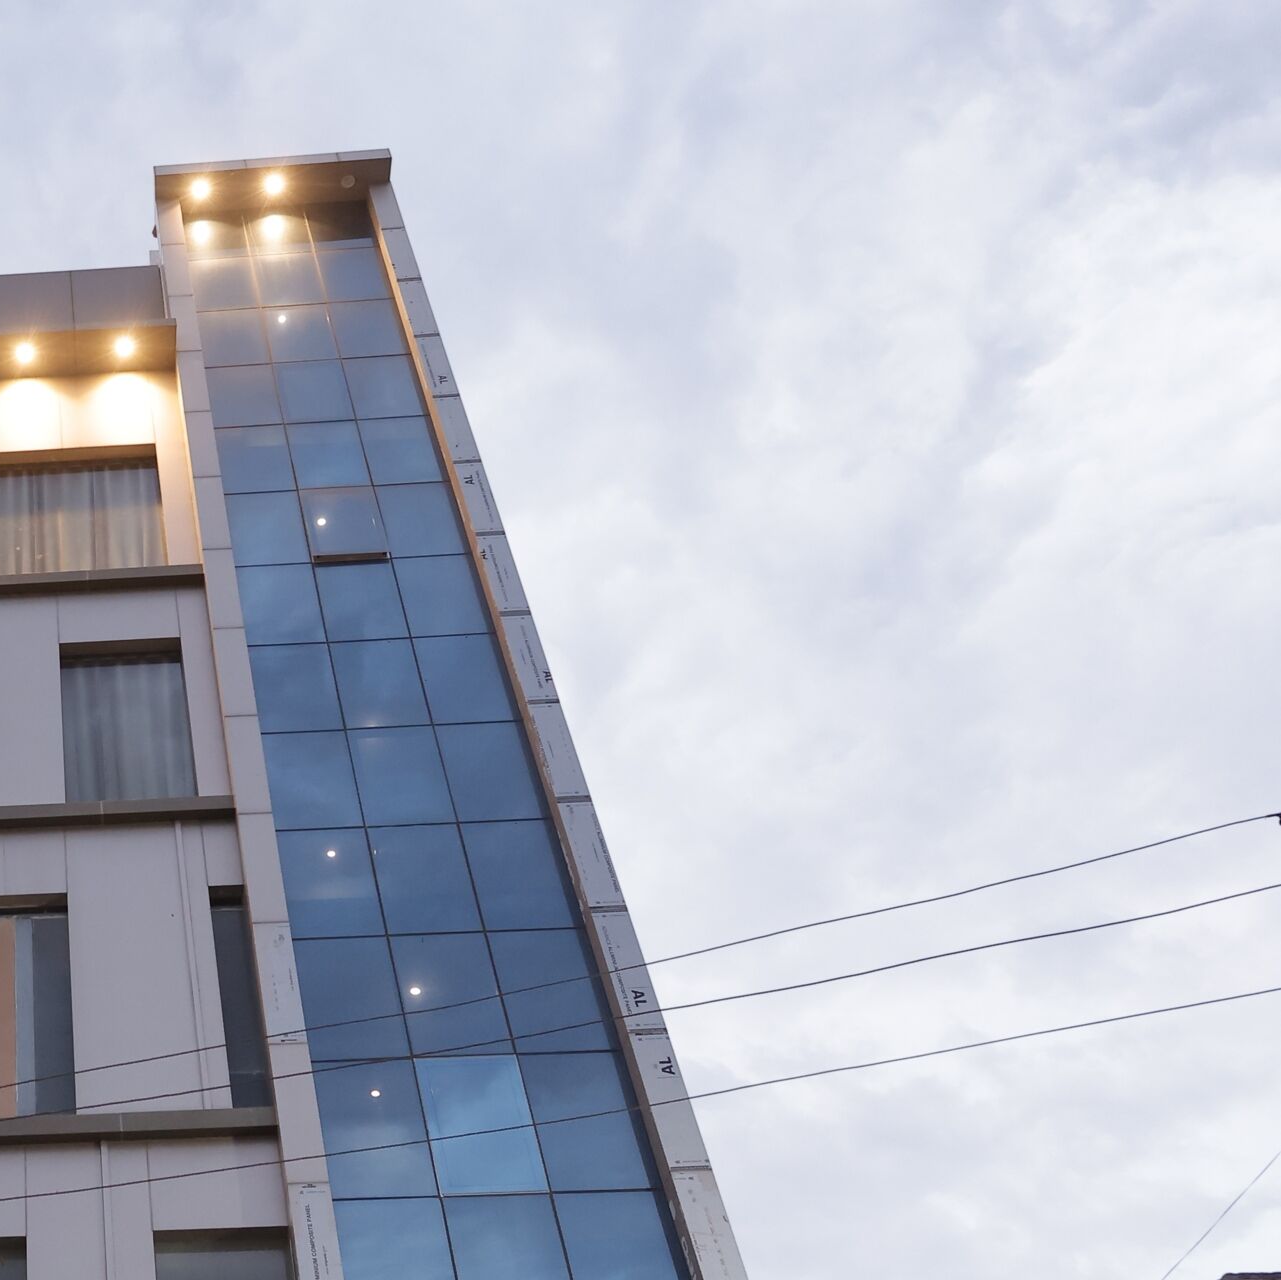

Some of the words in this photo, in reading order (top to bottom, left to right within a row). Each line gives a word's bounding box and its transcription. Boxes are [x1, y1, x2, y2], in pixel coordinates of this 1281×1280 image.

[463, 474, 475, 485] AL
[631, 989, 647, 1007] AL
[659, 1056, 675, 1075] AL
[307, 1223, 317, 1256] COMPOSITE
